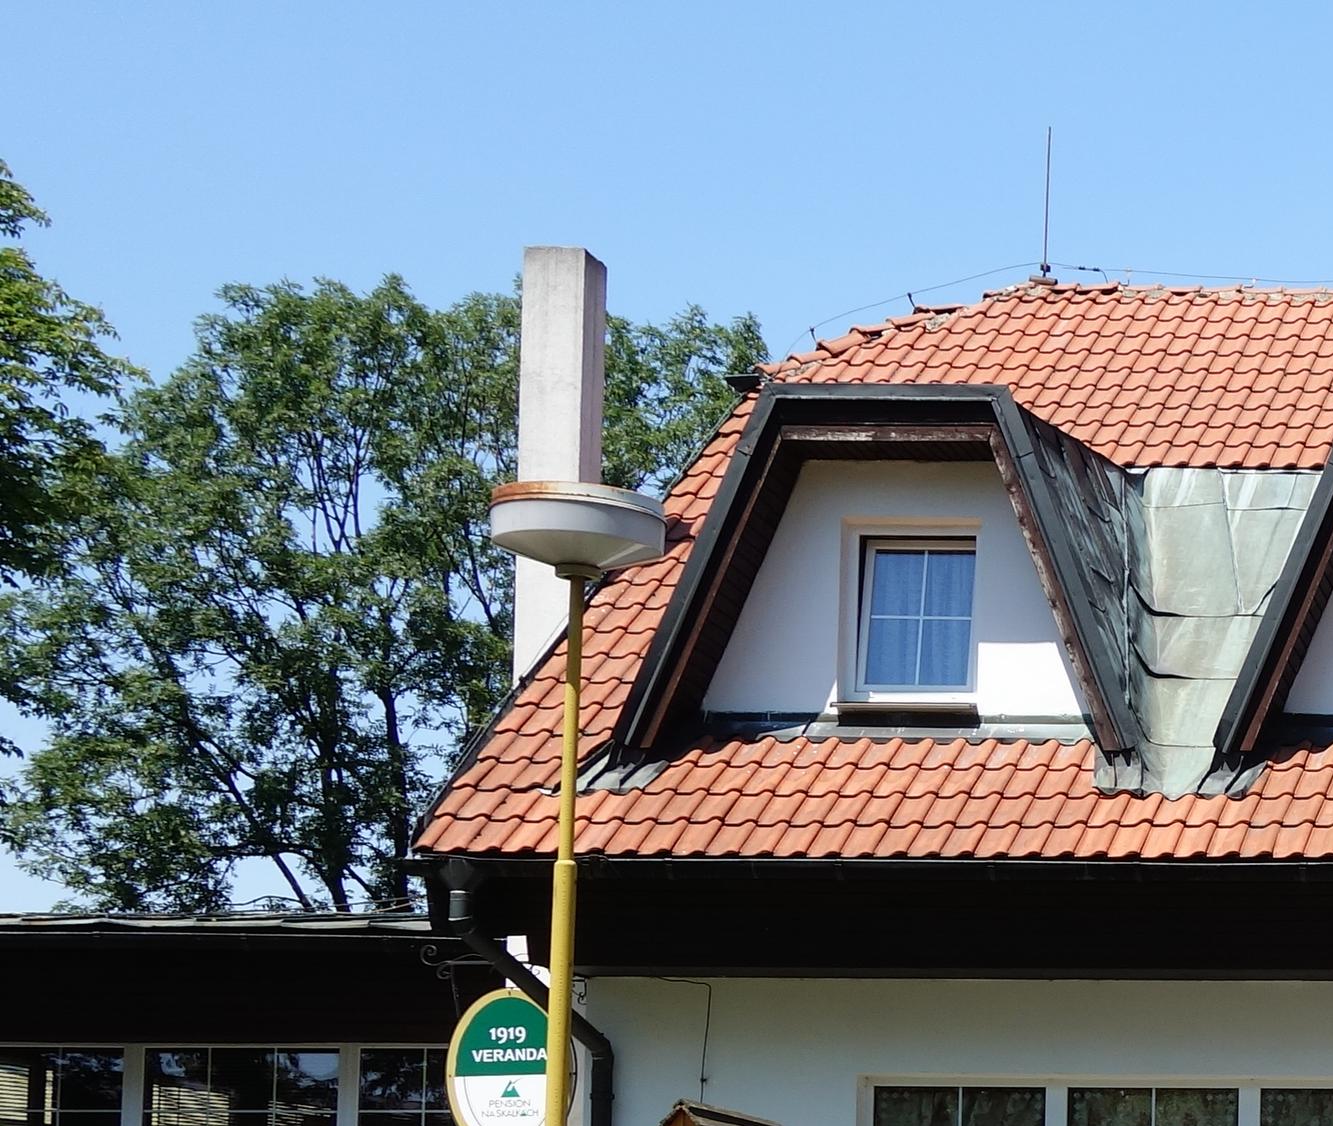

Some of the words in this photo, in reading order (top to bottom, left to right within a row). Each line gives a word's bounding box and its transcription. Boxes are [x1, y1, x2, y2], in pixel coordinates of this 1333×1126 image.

[489, 1026, 526, 1043] 1919
[472, 1048, 548, 1062] VERANDA
[488, 1100, 531, 1108] PENSION
[481, 1110, 495, 1118] NA
